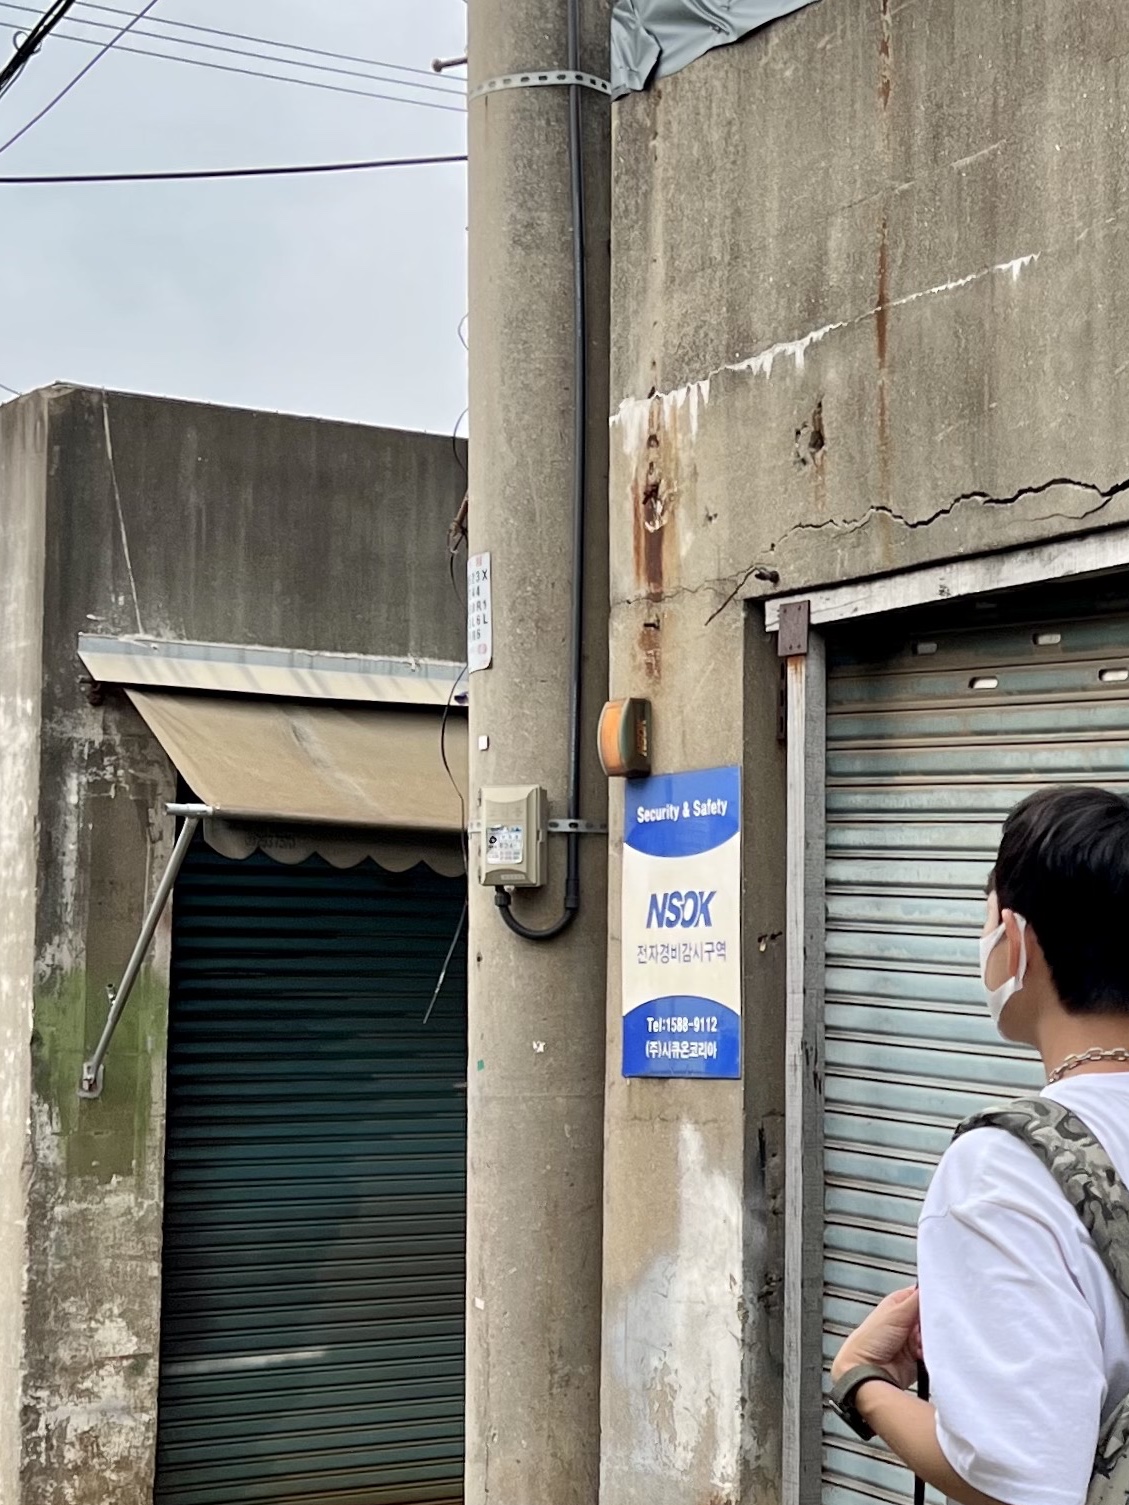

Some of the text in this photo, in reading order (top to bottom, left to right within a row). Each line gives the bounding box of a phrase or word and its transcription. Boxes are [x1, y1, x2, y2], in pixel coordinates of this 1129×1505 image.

[637, 798, 728, 823] Security & Safety
[646, 890, 717, 929] NSOK
[637, 941, 726, 964] 전자경비감시구역
[646, 1016, 718, 1033] Tel:1588-9112
[645, 1041, 718, 1059] (주)시큐온코리아
